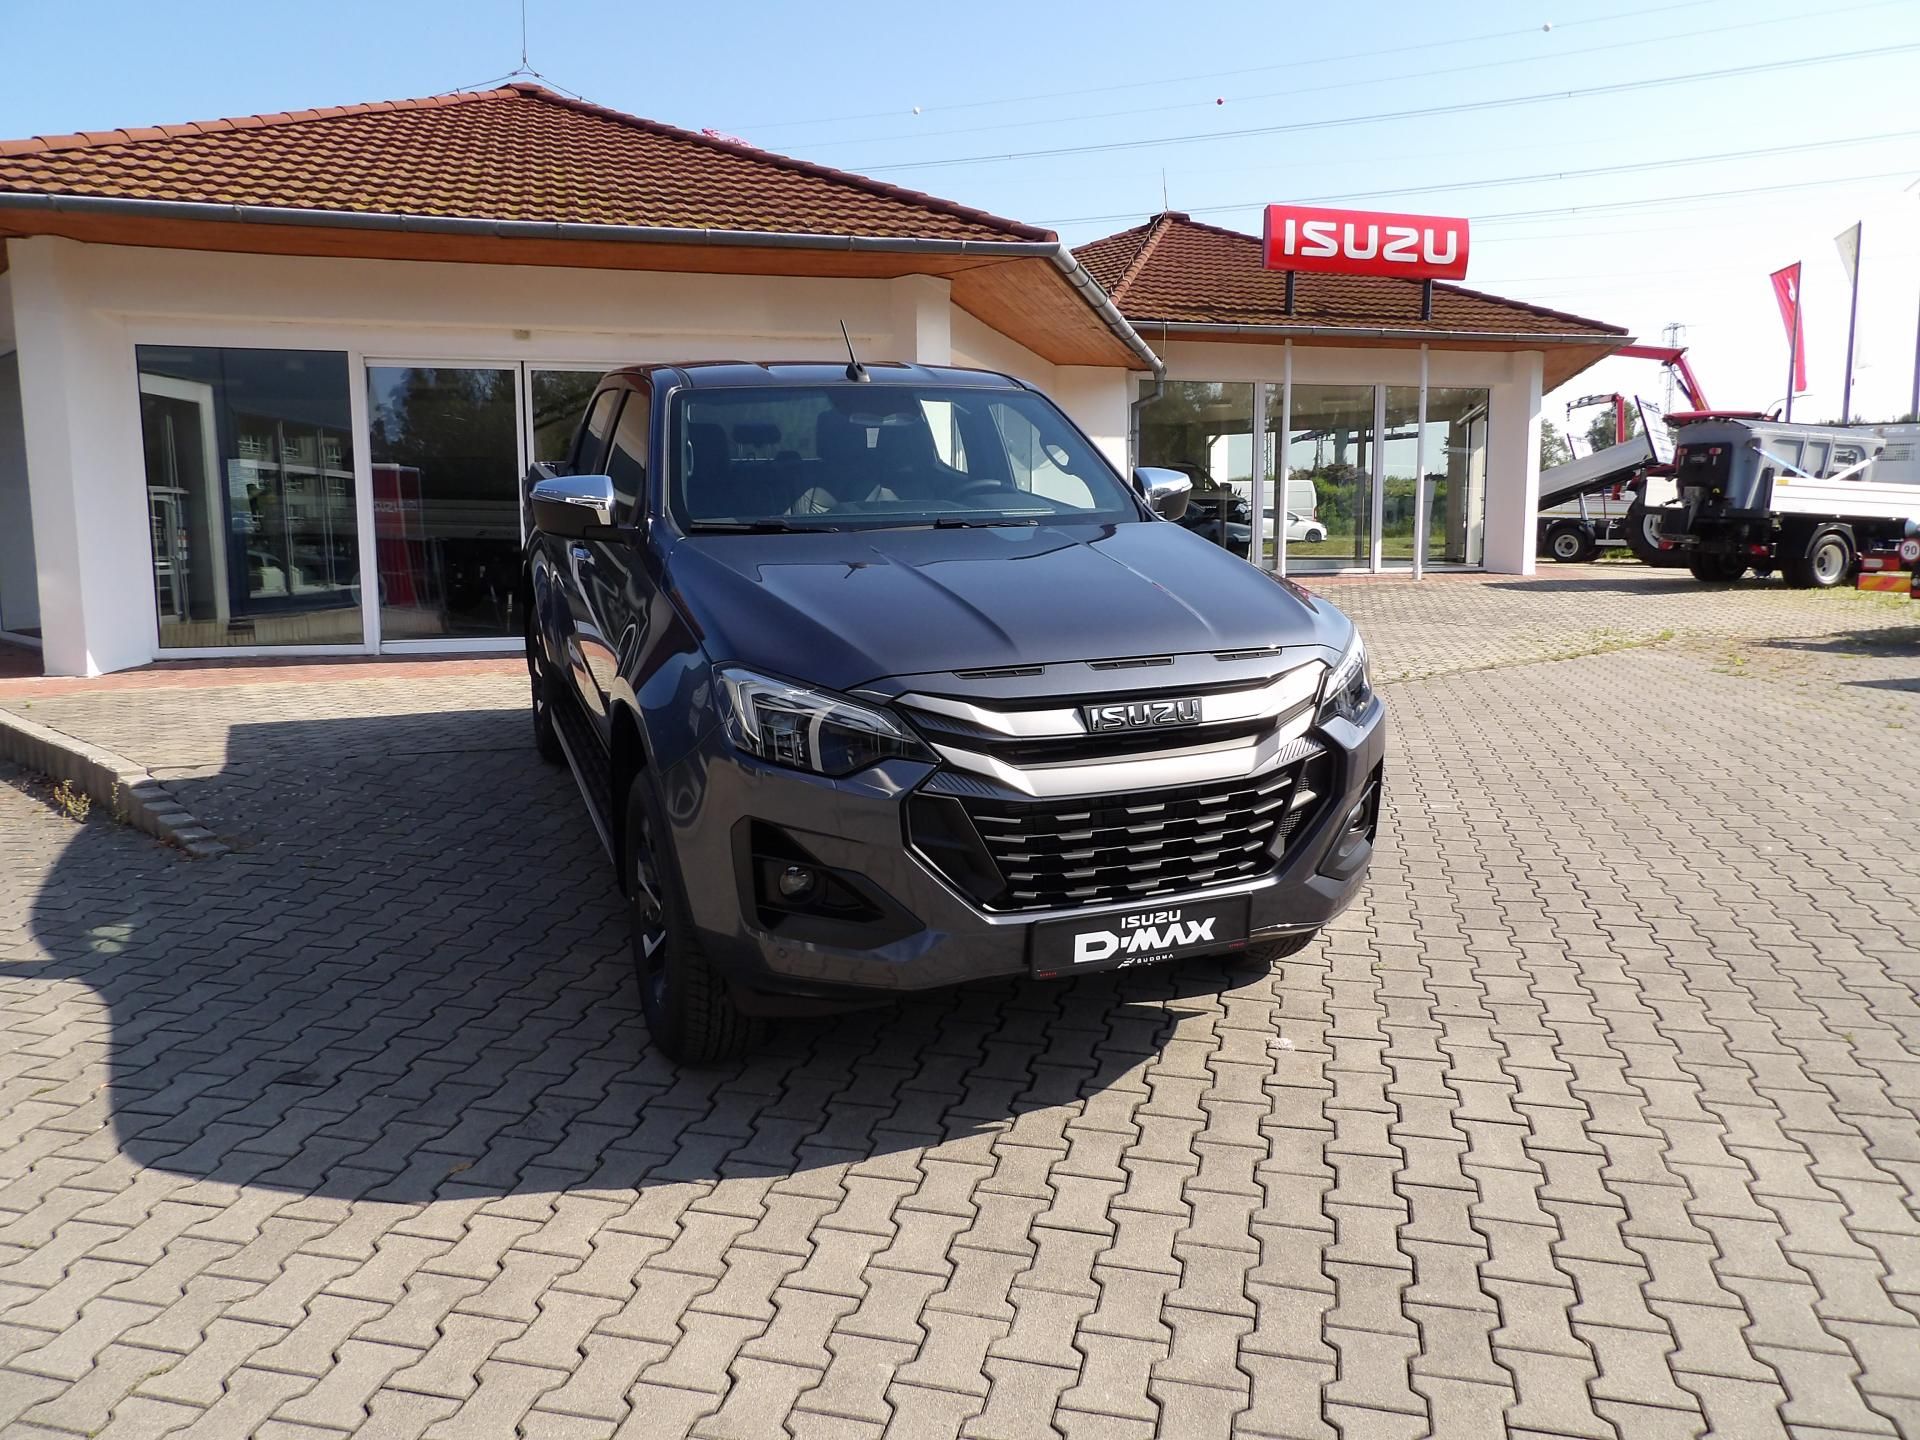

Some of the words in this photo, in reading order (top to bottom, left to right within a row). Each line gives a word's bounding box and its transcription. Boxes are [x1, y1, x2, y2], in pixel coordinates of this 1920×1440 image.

[1284, 219, 1457, 265] ISUZU
[1904, 545, 1917, 555] 90
[1090, 700, 1199, 731] ISUZU
[1121, 909, 1181, 929] ISUZU
[1074, 917, 1216, 963] D-MAX
